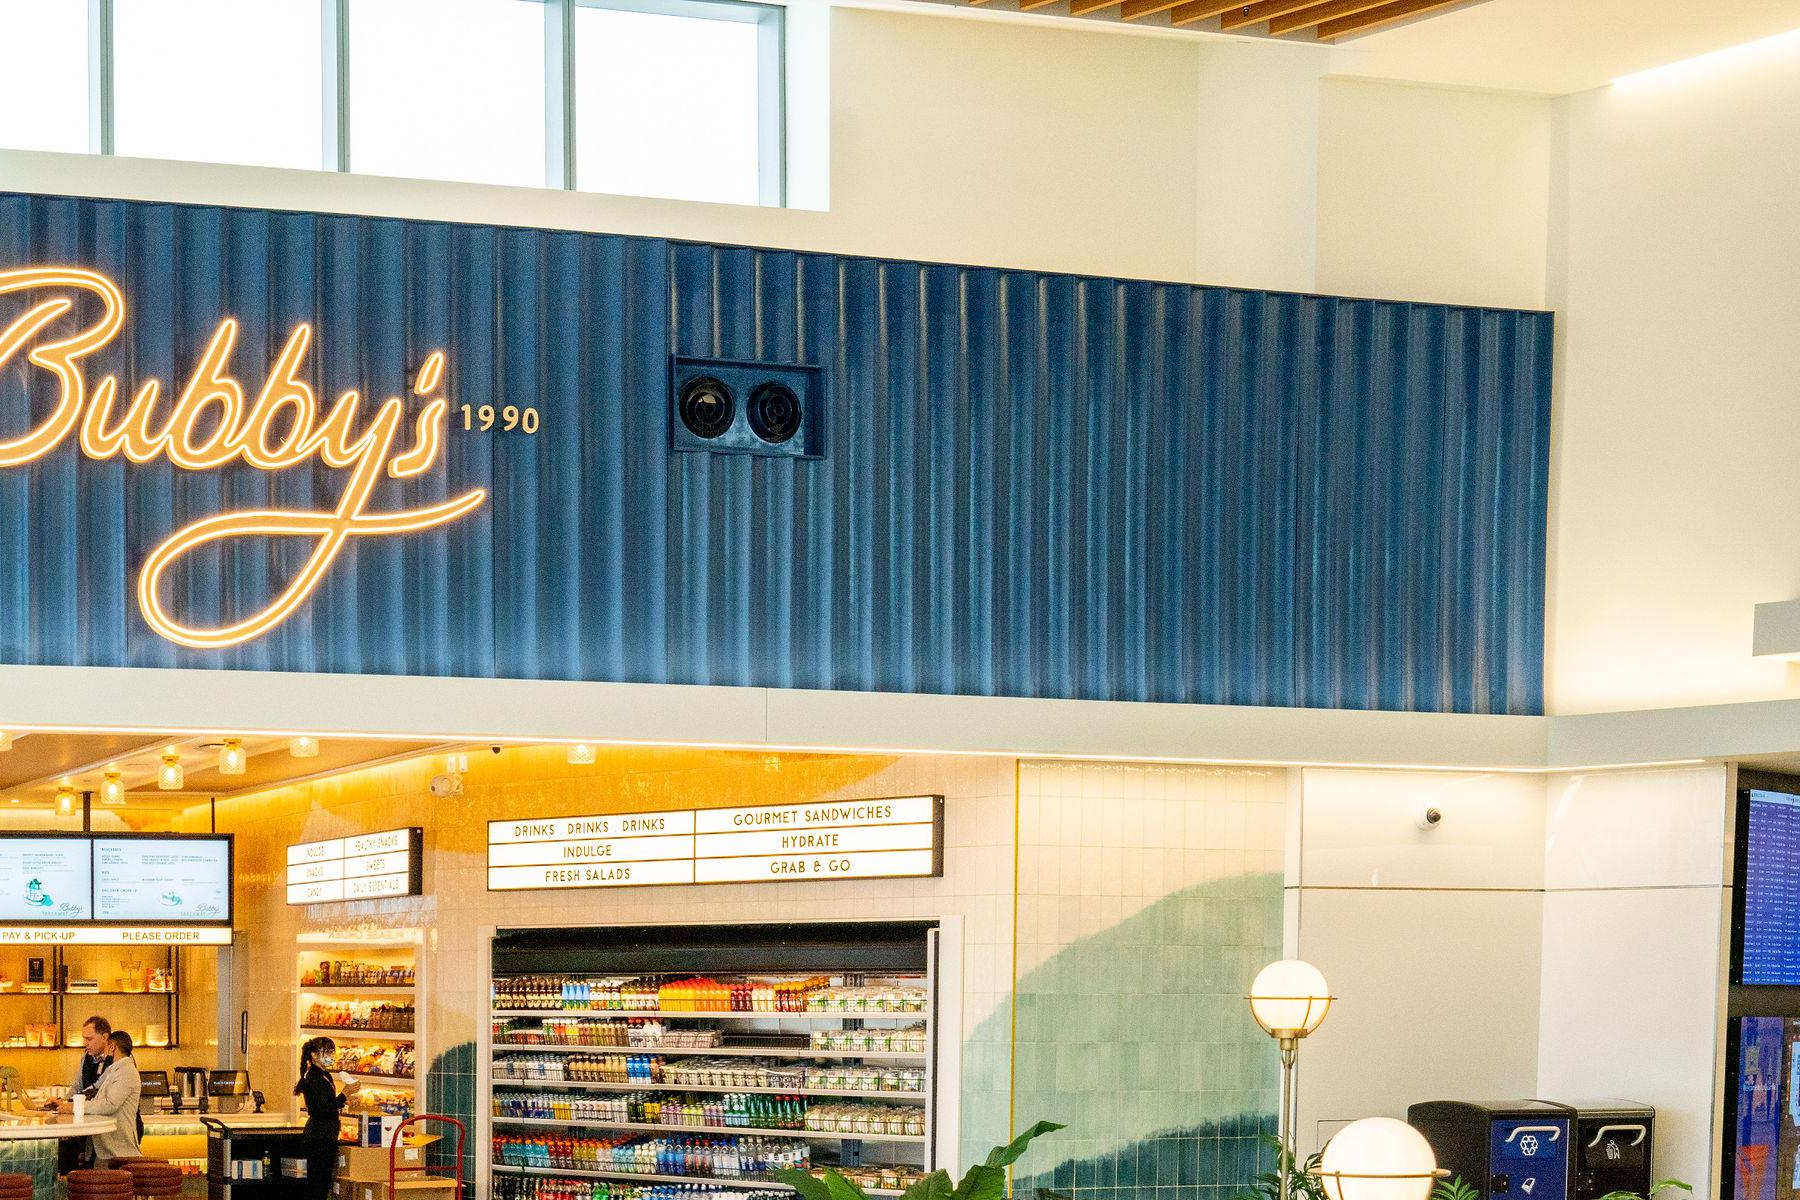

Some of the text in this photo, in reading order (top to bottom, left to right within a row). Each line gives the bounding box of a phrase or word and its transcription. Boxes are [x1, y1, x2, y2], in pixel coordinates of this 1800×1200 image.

[462, 404, 540, 434] 1990
[733, 805, 892, 826] GOURMET SANDWICHES
[515, 818, 665, 837] DRINKS DRINKS DRINKS
[782, 834, 839, 848] HYDRATE
[563, 845, 612, 858] INDULGE
[770, 861, 806, 874] GRAB
[829, 859, 851, 872] GO
[545, 868, 630, 882] FRESH SALADS
[2, 931, 21, 940] PAY
[24, 931, 31, 940] &
[34, 931, 76, 940] PICK-UP
[122, 931, 200, 941] PLEASE ORDER
